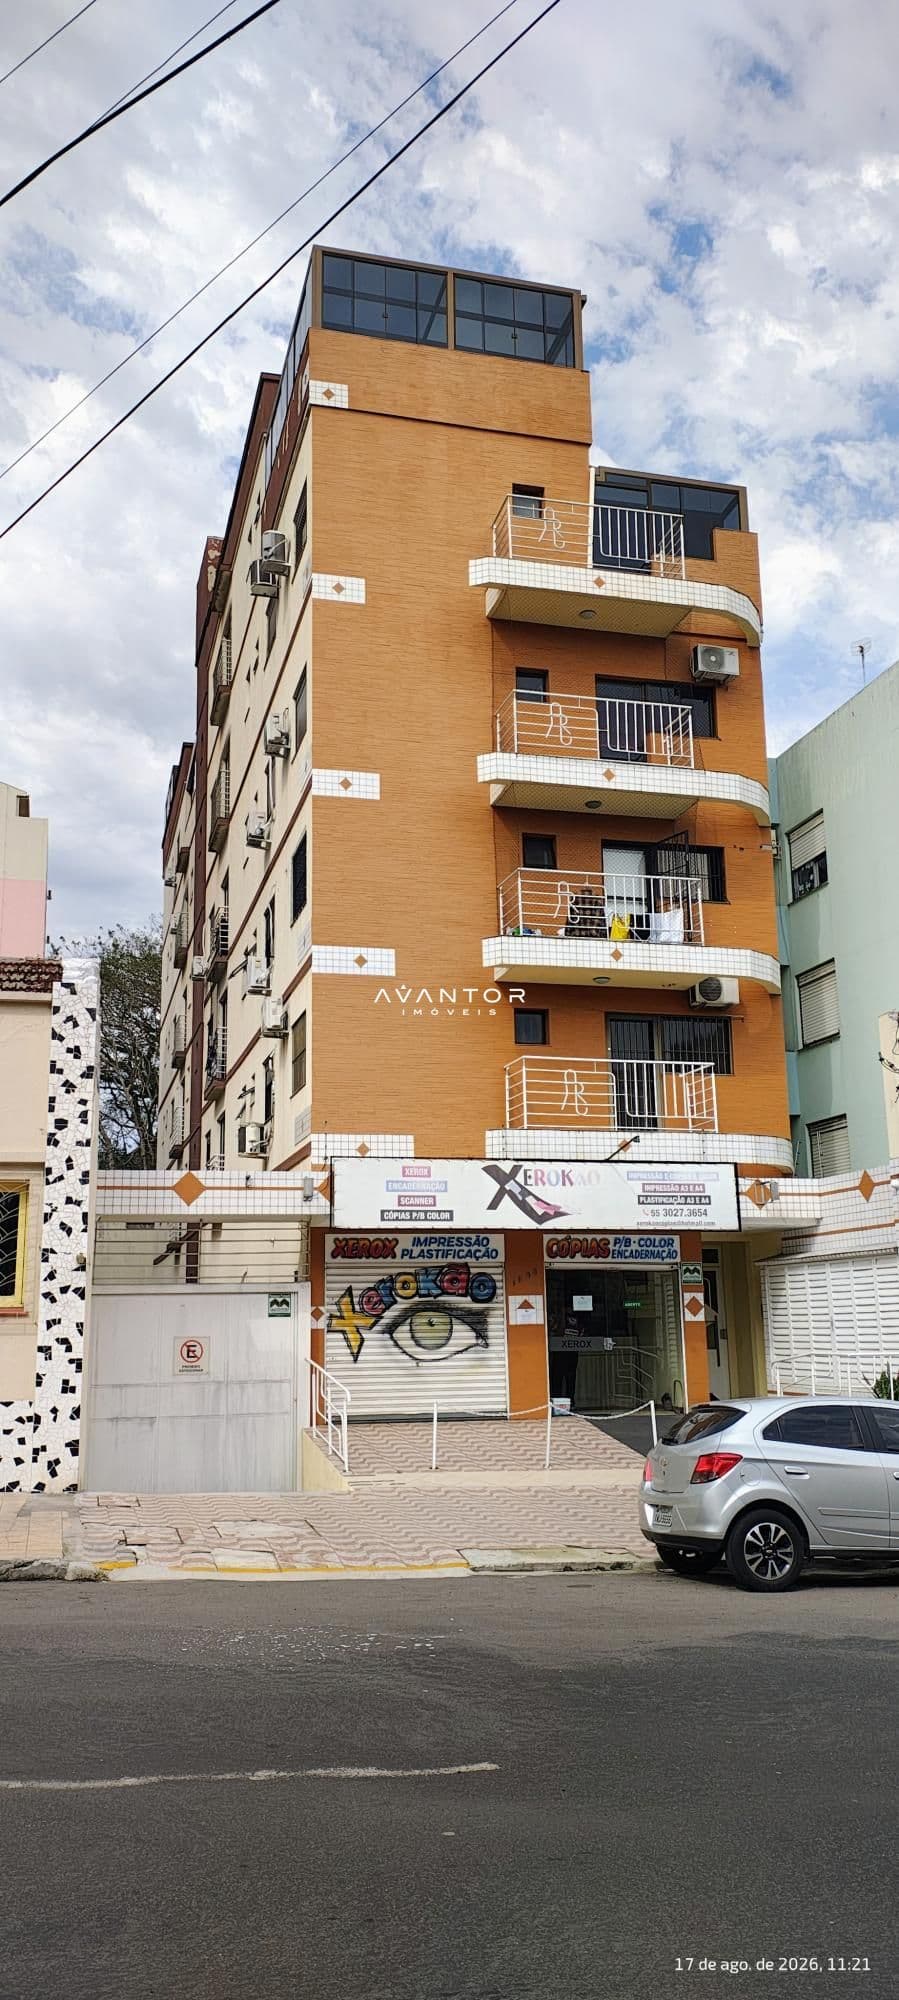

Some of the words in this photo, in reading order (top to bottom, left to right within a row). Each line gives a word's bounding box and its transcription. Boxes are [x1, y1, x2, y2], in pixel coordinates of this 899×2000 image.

[404, 1167, 429, 1176] XEROX
[644, 1183, 679, 1192] IMPRESSÃO
[680, 1184, 688, 1192] A3
[400, 1196, 434, 1205] SCANNER
[687, 1196, 694, 1204] A3
[701, 1197, 709, 1205] A4
[383, 1210, 410, 1220] CÓPIAS
[412, 1212, 425, 1220] P/B
[427, 1212, 450, 1220] COLOR
[663, 1208, 708, 1218] 3027.3654
[411, 1235, 490, 1248] IMPRESSÃO
[638, 1237, 675, 1249] COLOR
[332, 1238, 398, 1259] XEROX
[546, 1235, 611, 1260] CÓPIAS
[400, 1246, 499, 1261] PLASTIFICAÇÃO
[611, 1248, 678, 1261] ENCADERNAÇÃO
[561, 1339, 592, 1349] XEROX
